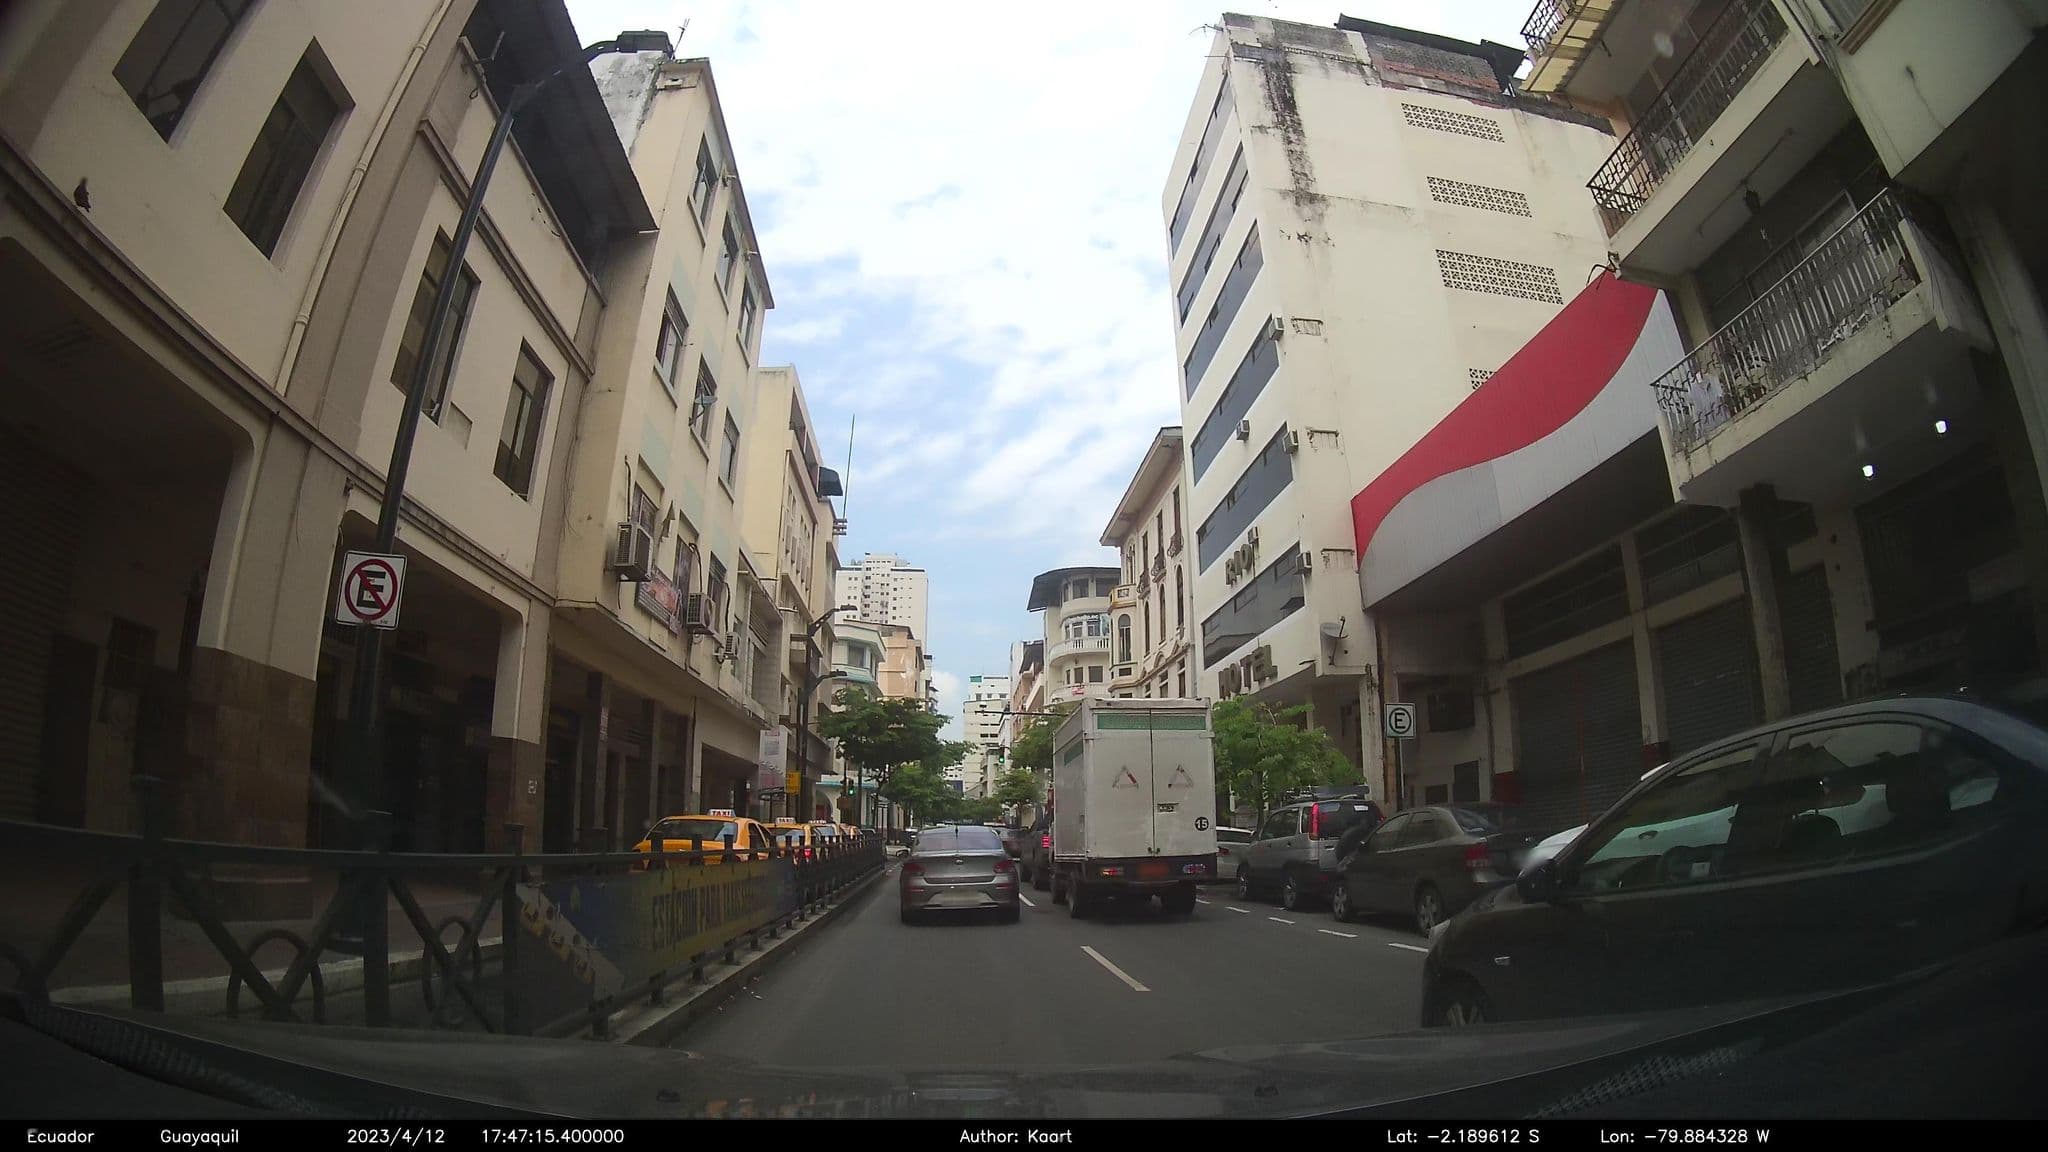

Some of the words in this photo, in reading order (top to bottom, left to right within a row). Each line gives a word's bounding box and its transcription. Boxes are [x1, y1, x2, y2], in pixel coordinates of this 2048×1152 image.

[356, 570, 386, 610] E
[1218, 644, 1278, 699] HOTEL
[1394, 712, 1406, 729] E
[1195, 819, 1208, 829] 15
